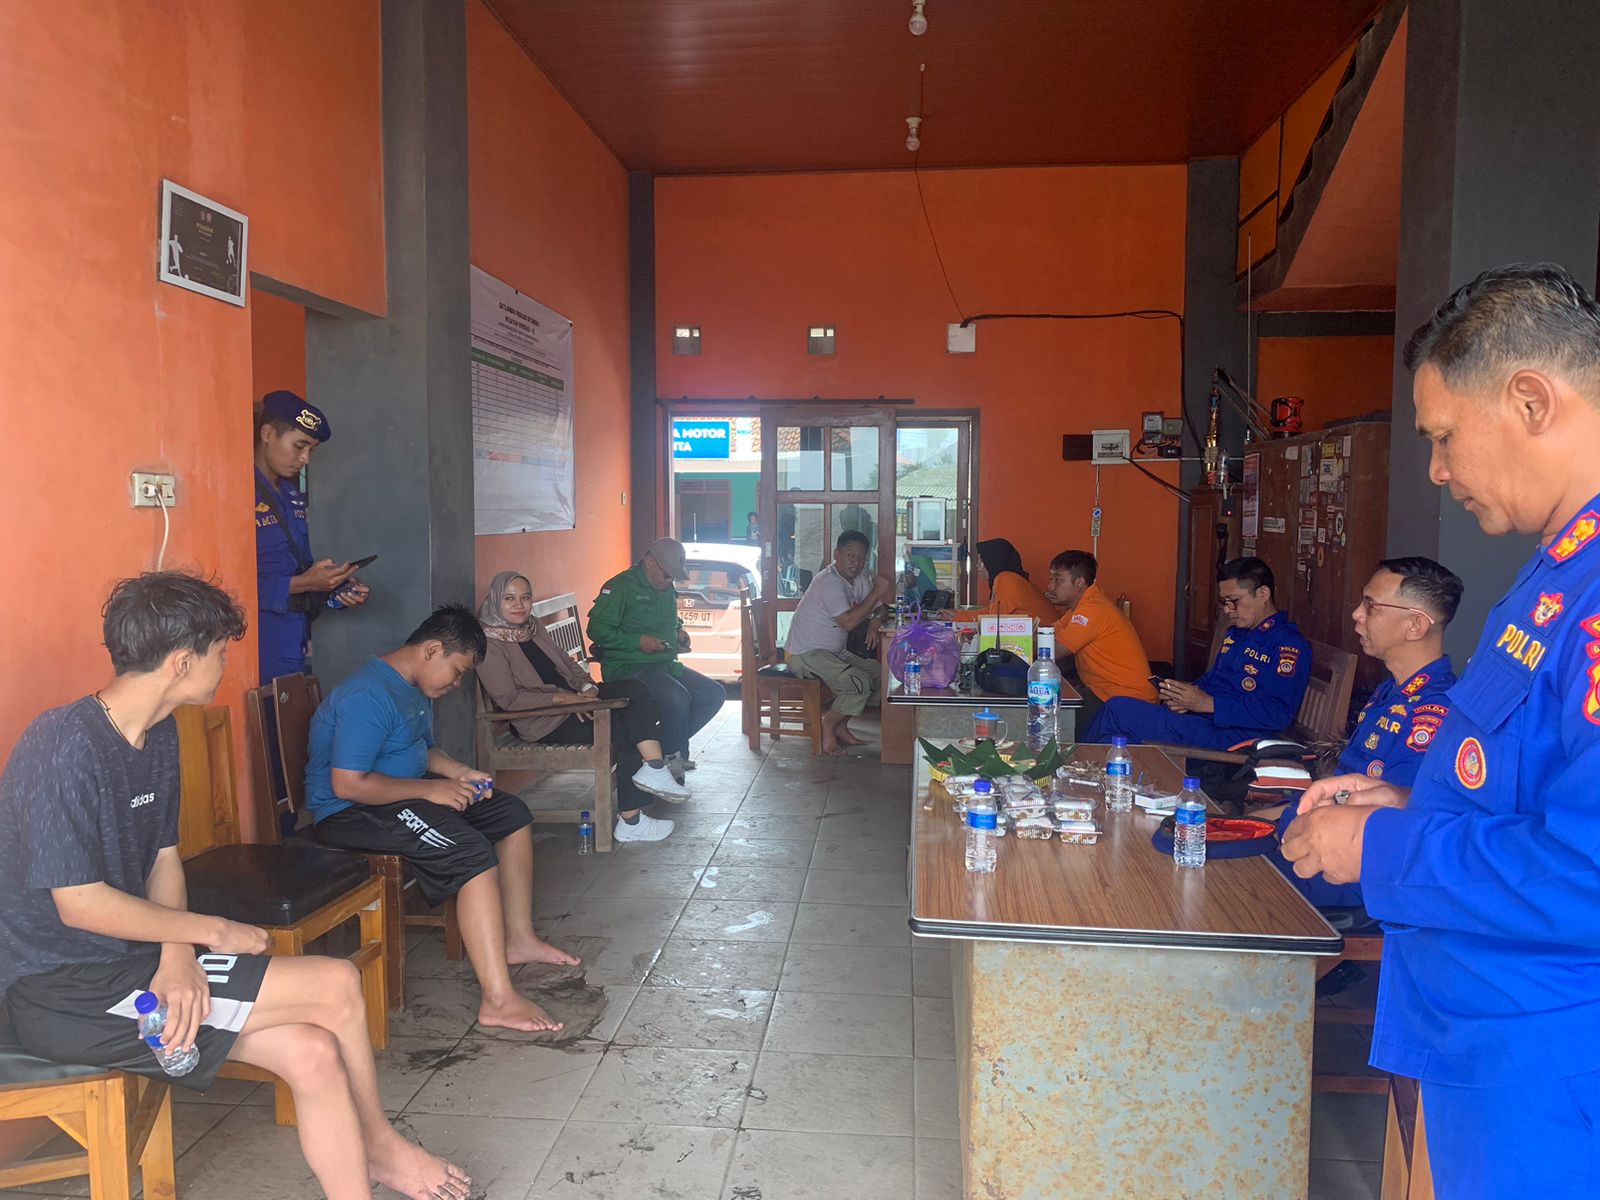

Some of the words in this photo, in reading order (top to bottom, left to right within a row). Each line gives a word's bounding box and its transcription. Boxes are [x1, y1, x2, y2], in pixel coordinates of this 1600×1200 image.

[682, 428, 726, 438] MOTOR
[701, 612, 712, 622] UT
[1244, 647, 1271, 664] POLRI
[1497, 624, 1546, 671] POLRI
[1029, 685, 1050, 697] AQUA
[130, 792, 155, 809] adidas
[397, 808, 430, 834] SPORT
